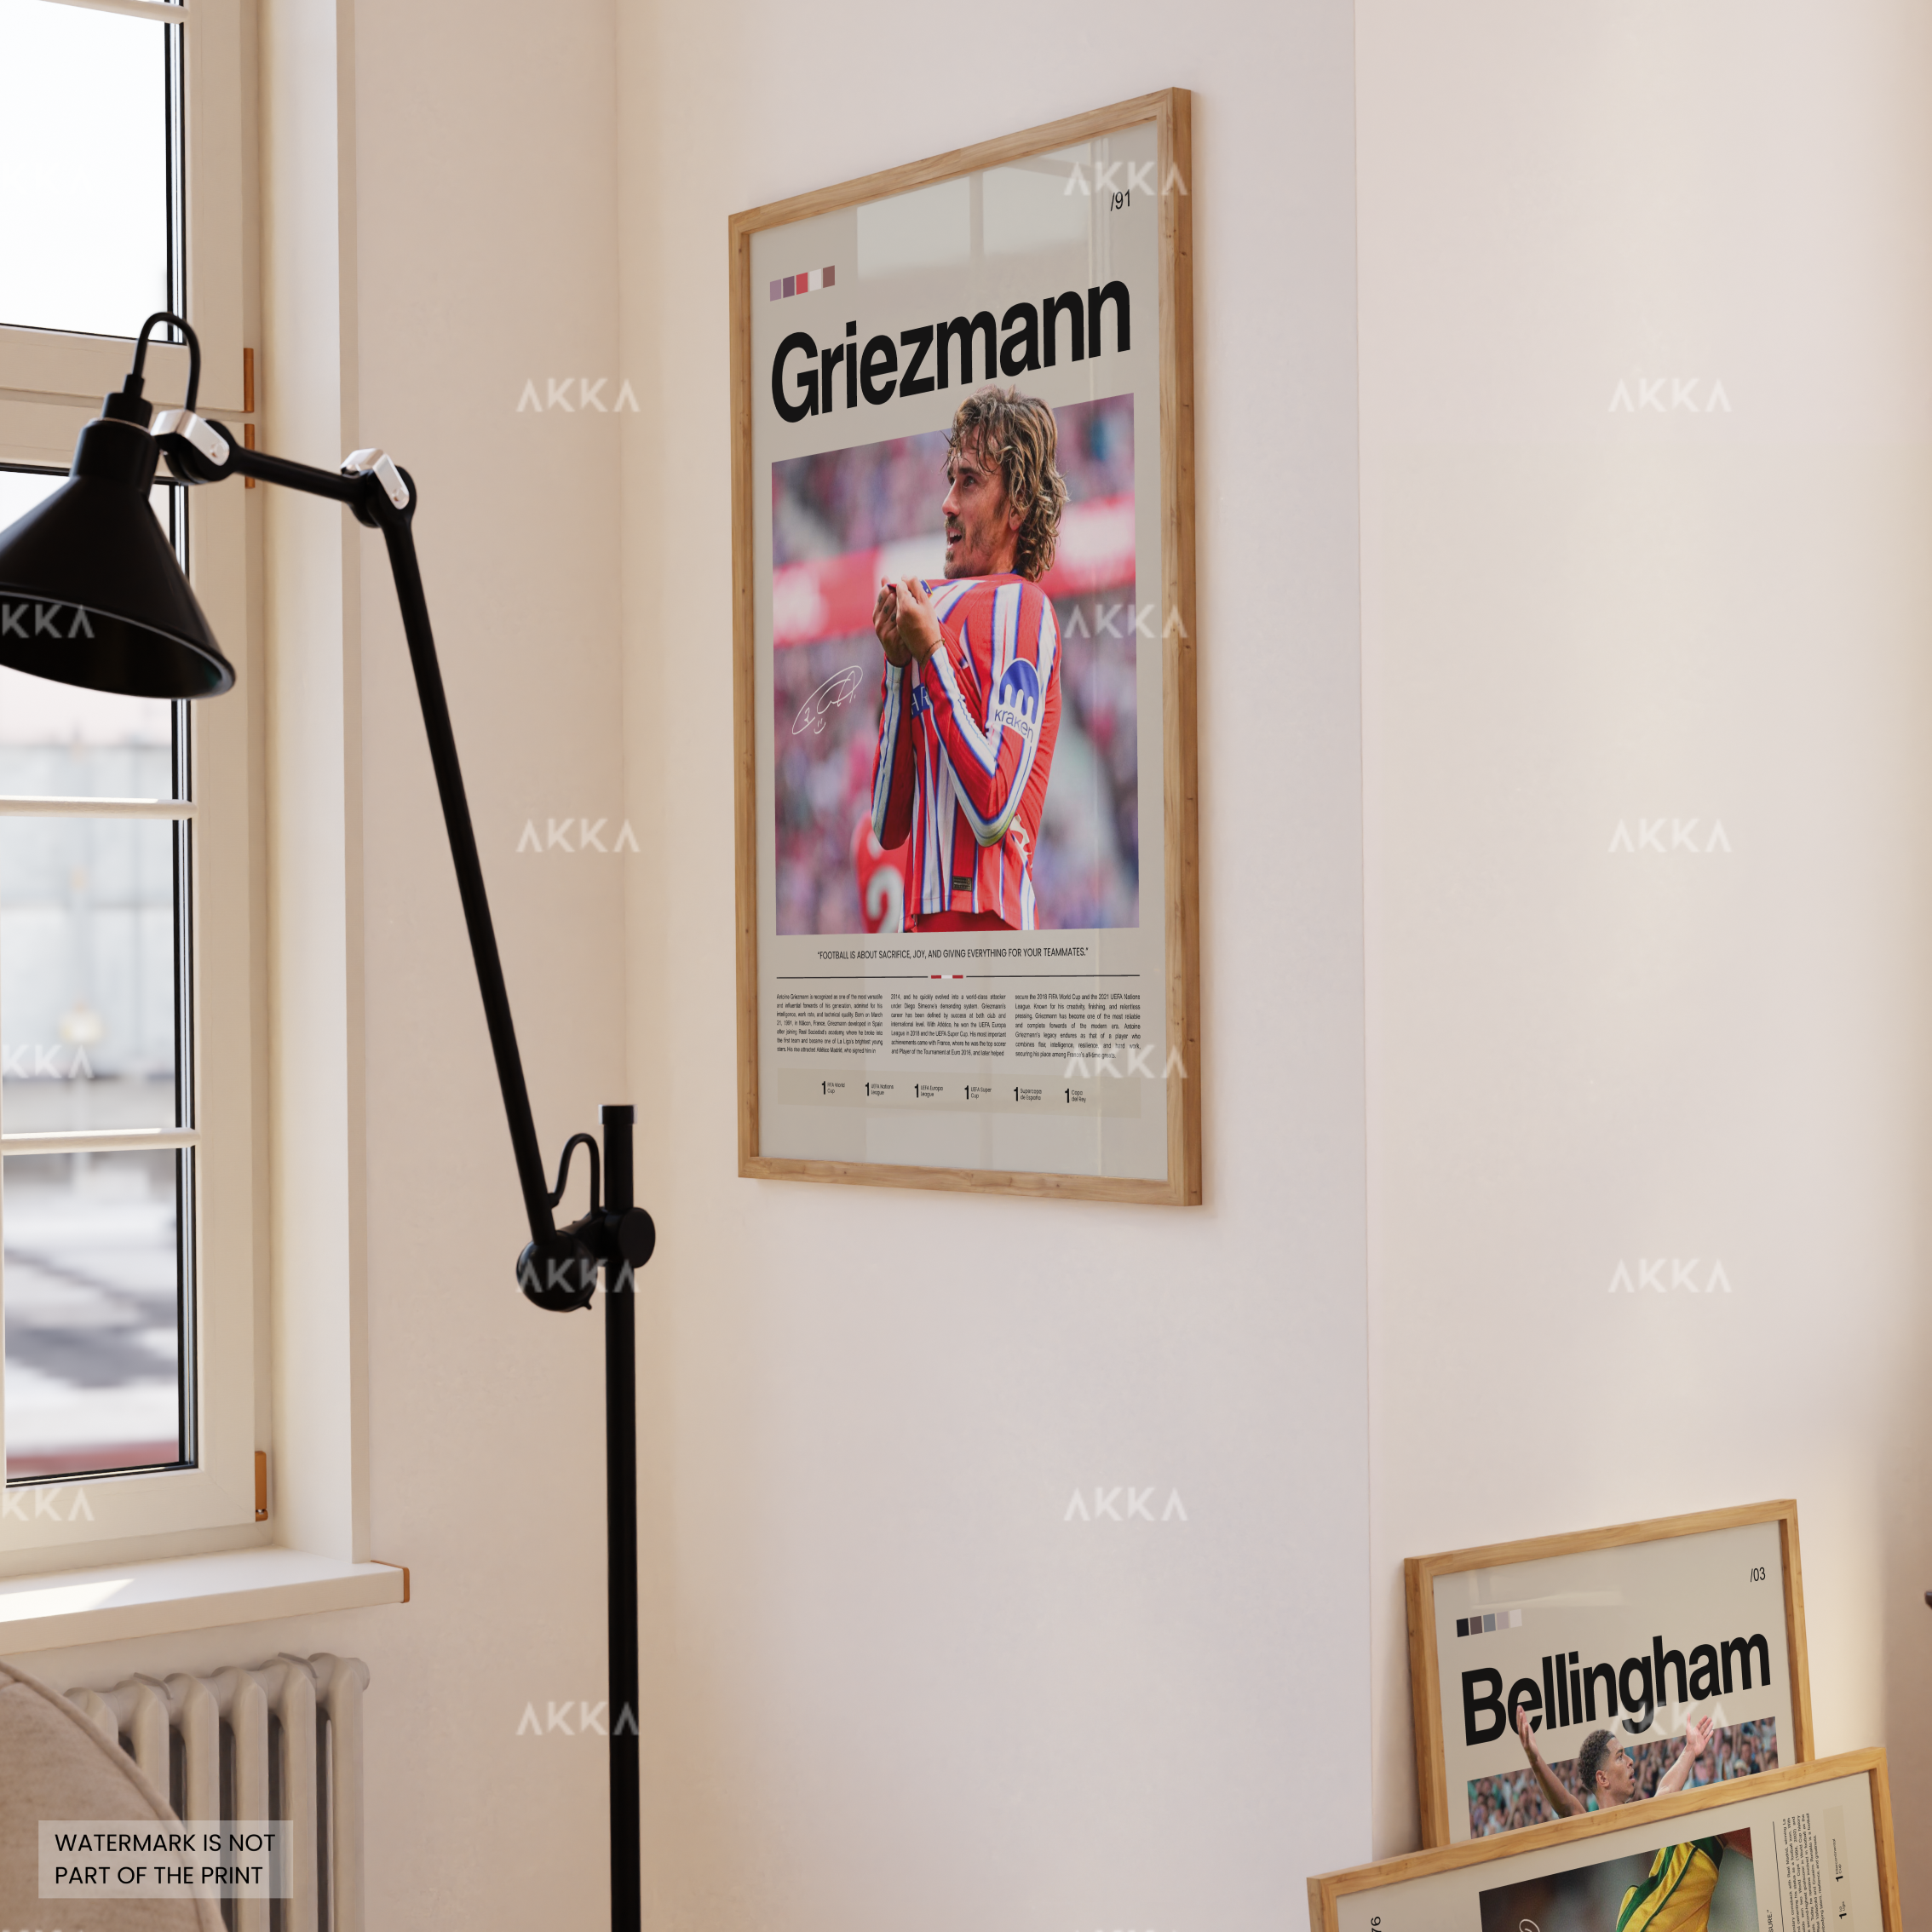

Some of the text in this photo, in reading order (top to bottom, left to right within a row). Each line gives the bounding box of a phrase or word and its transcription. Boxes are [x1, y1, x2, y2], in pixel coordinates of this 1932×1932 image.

[1110, 189, 1130, 212] /91
[771, 280, 1130, 423] Griezmann
[994, 709, 1034, 744] kraken
[856, 950, 877, 958] ABOUT
[878, 949, 911, 959] SACRIFICE,
[912, 949, 927, 959] JOY,
[927, 949, 941, 957] AND
[942, 949, 966, 957] GIVING
[967, 948, 1007, 957] EVERYTHING
[1008, 947, 1021, 957] FOR
[1022, 947, 1042, 957] YOUR
[1043, 1031, 1056, 1039] legacy
[1114, 1032, 1128, 1040] player
[1039, 1049, 1051, 1058] place
[822, 1081, 825, 1095] 1
[865, 1082, 870, 1096] 1
[914, 1084, 918, 1098] 1
[964, 1085, 969, 1100] 1
[1014, 1087, 1018, 1101] 1
[1065, 1088, 1069, 1103] 1
[1750, 1567, 1766, 1583] /03
[1461, 1632, 1771, 1746] Bellingham
